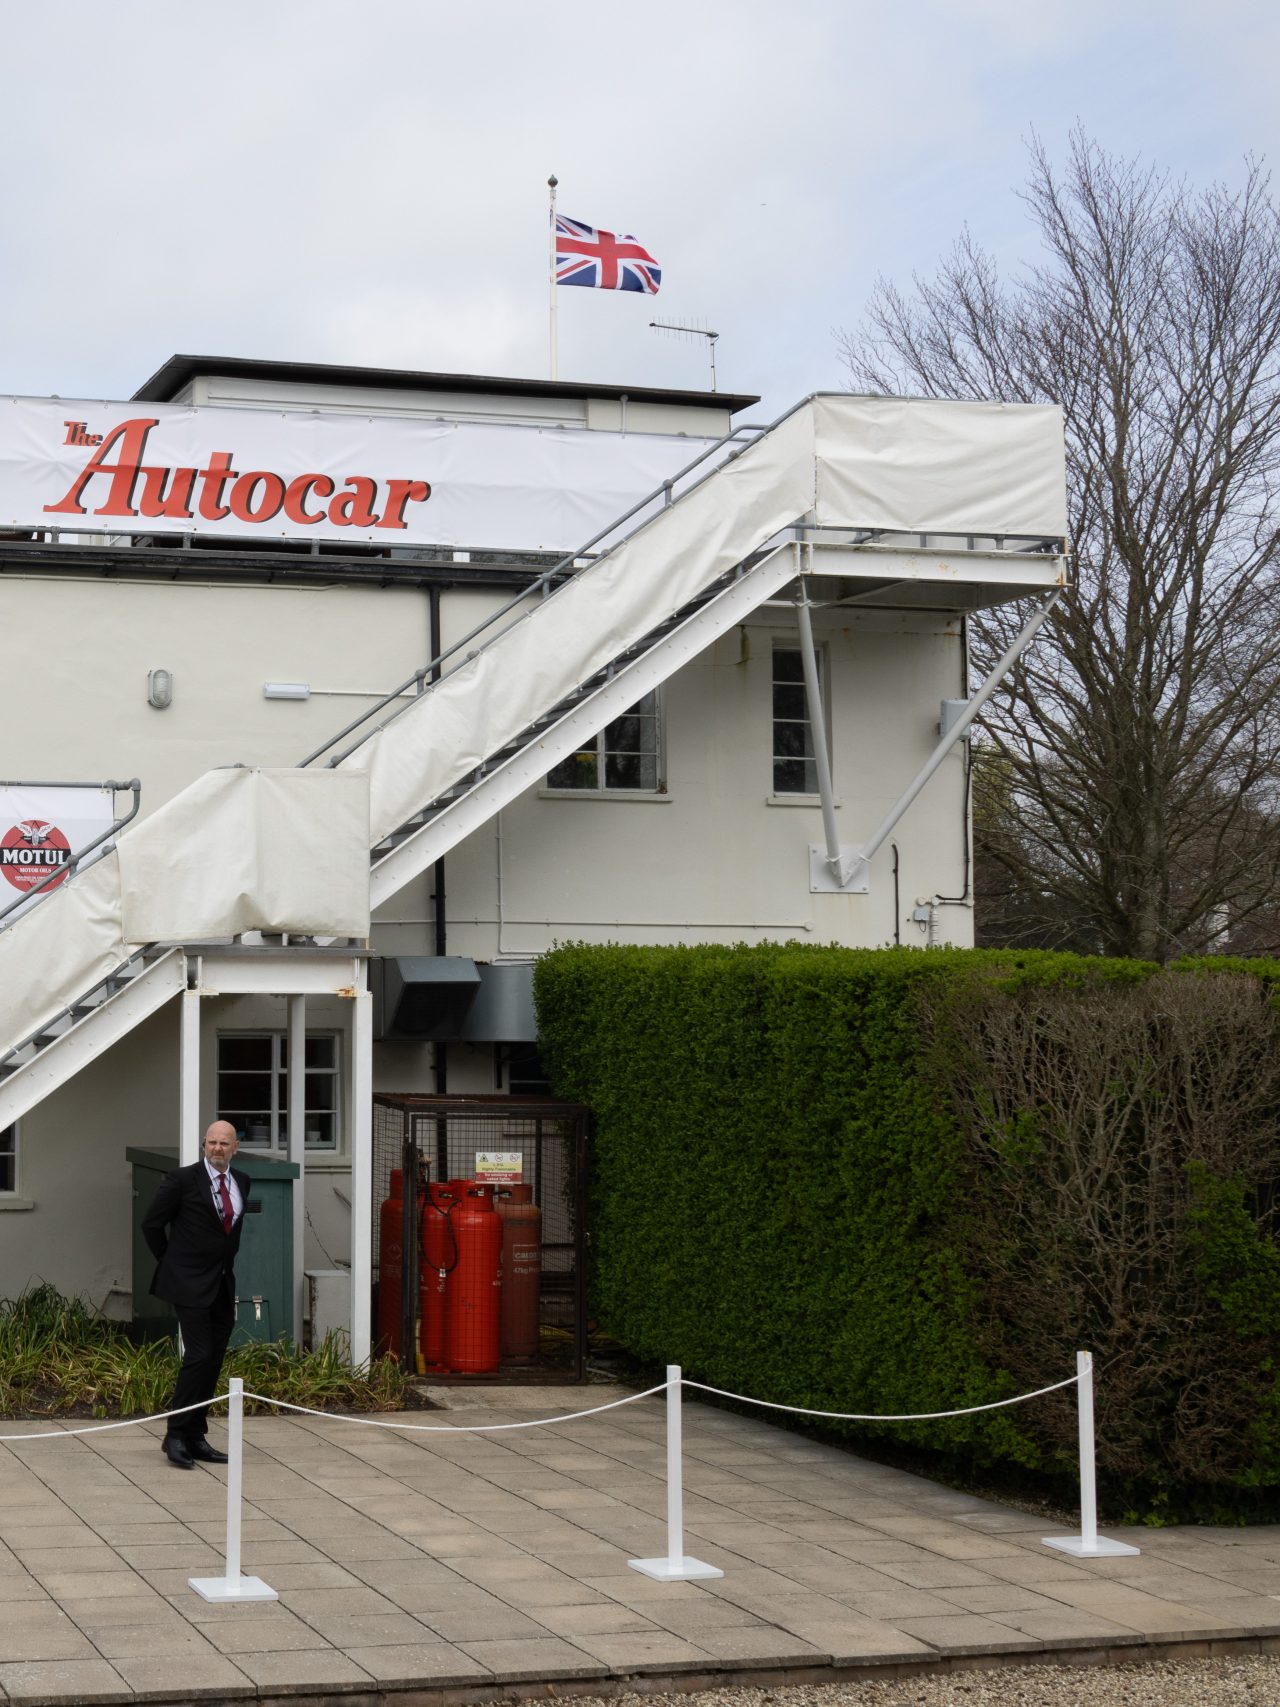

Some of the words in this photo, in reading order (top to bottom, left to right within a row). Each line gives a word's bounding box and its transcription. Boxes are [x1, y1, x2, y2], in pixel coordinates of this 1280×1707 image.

[62, 421, 103, 447] The
[43, 418, 431, 529] Autocar
[2, 849, 65, 865] MOTUL
